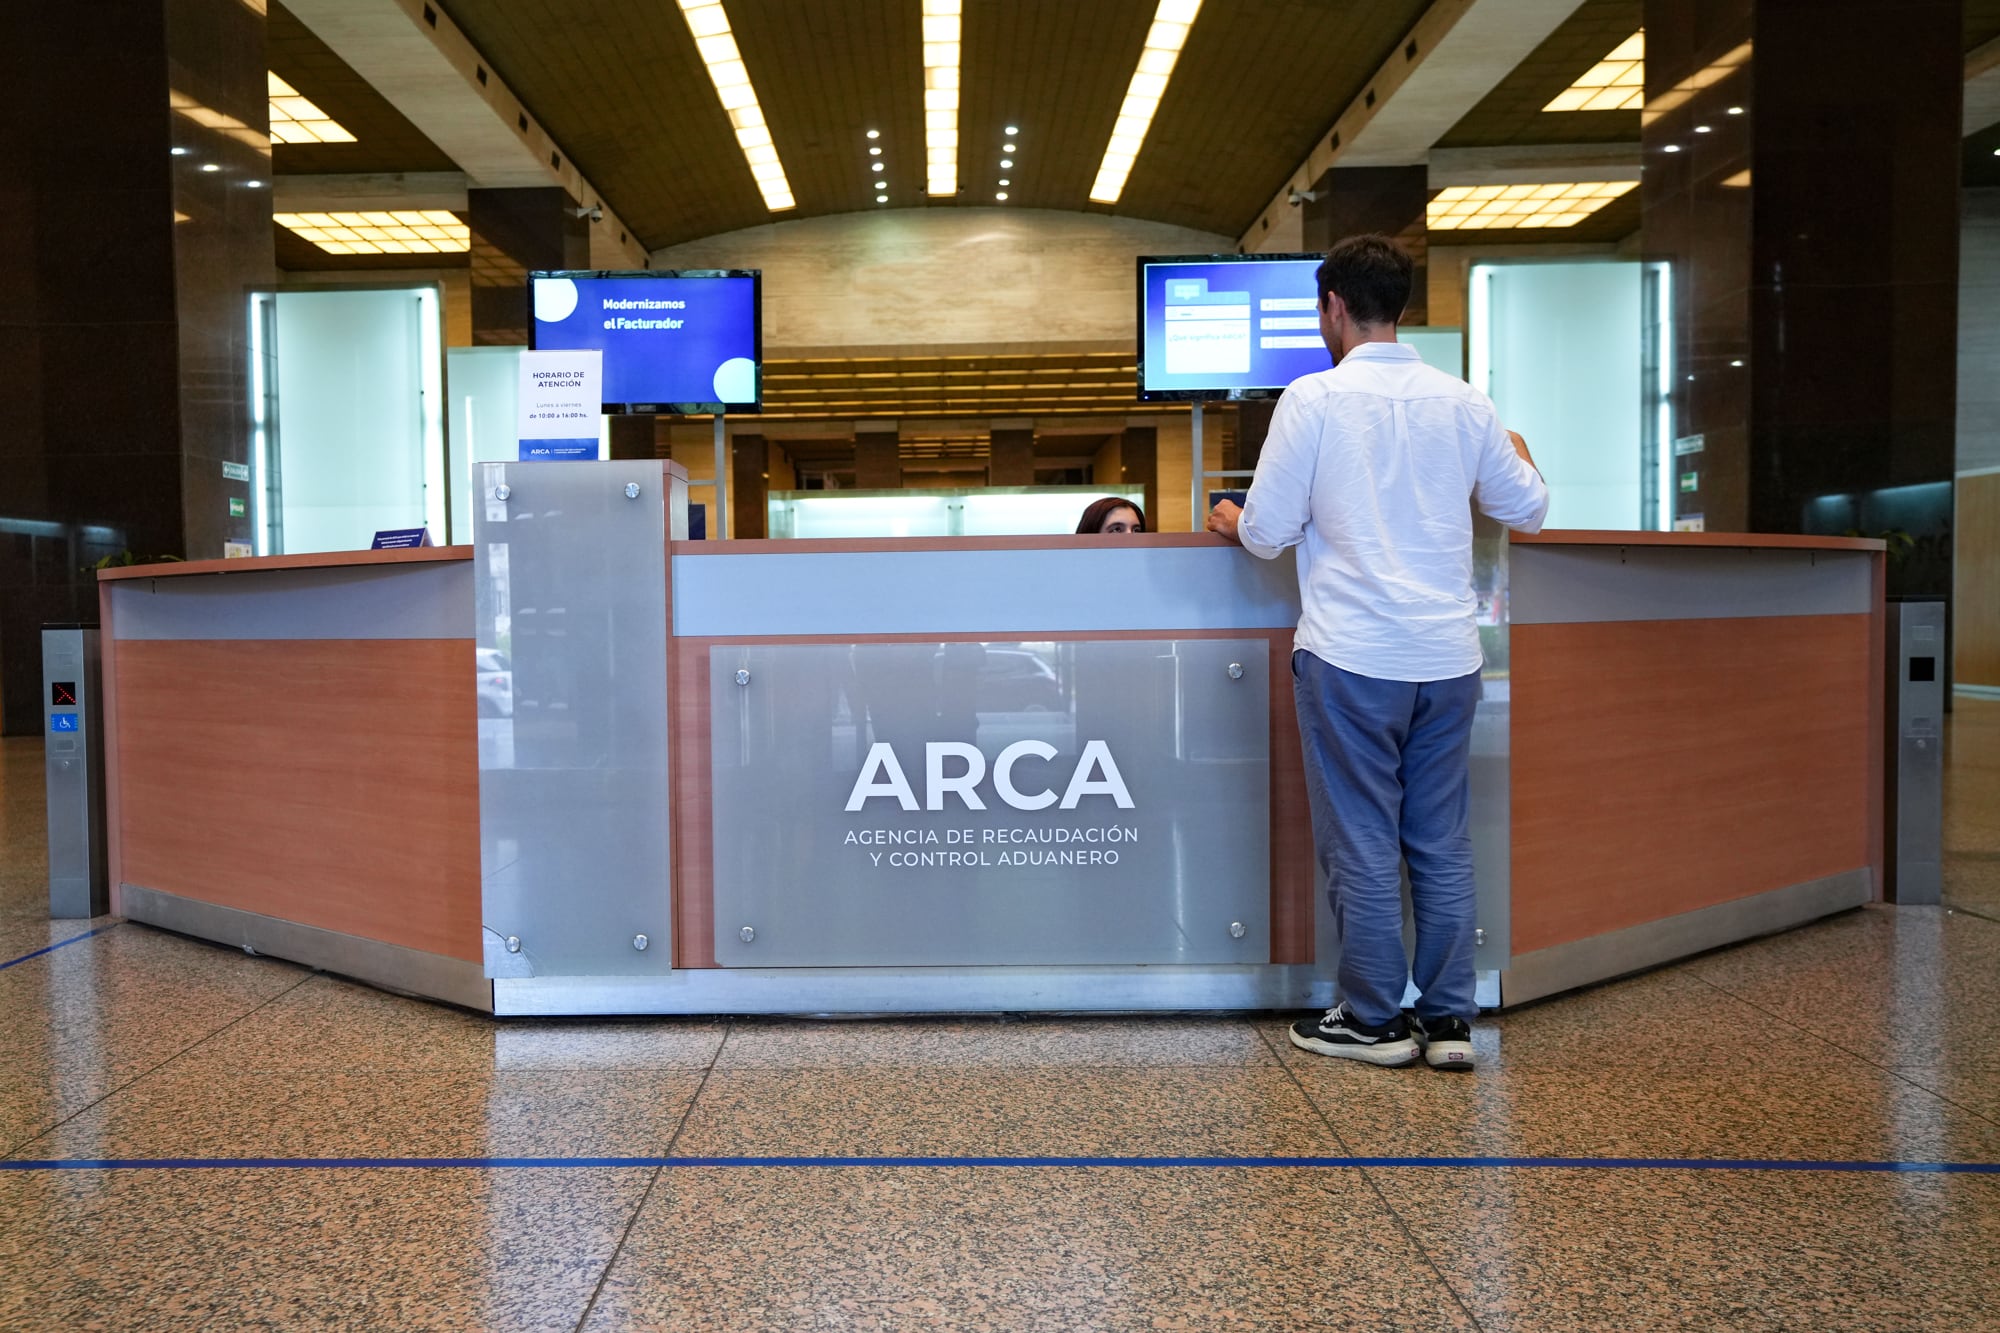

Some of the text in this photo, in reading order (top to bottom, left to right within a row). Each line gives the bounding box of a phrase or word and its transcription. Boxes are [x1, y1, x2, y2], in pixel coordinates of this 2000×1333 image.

[603, 298, 686, 310] Modernizamos
[603, 317, 684, 330] el Facturador
[532, 371, 572, 379] HORARIO
[537, 379, 582, 388] ATENCIÓN
[844, 739, 1136, 811] ARCA
[844, 825, 1139, 845] AGENCIA DE RECAUDACIÓN
[869, 850, 1119, 867] Y CONTROL ADUANERO
